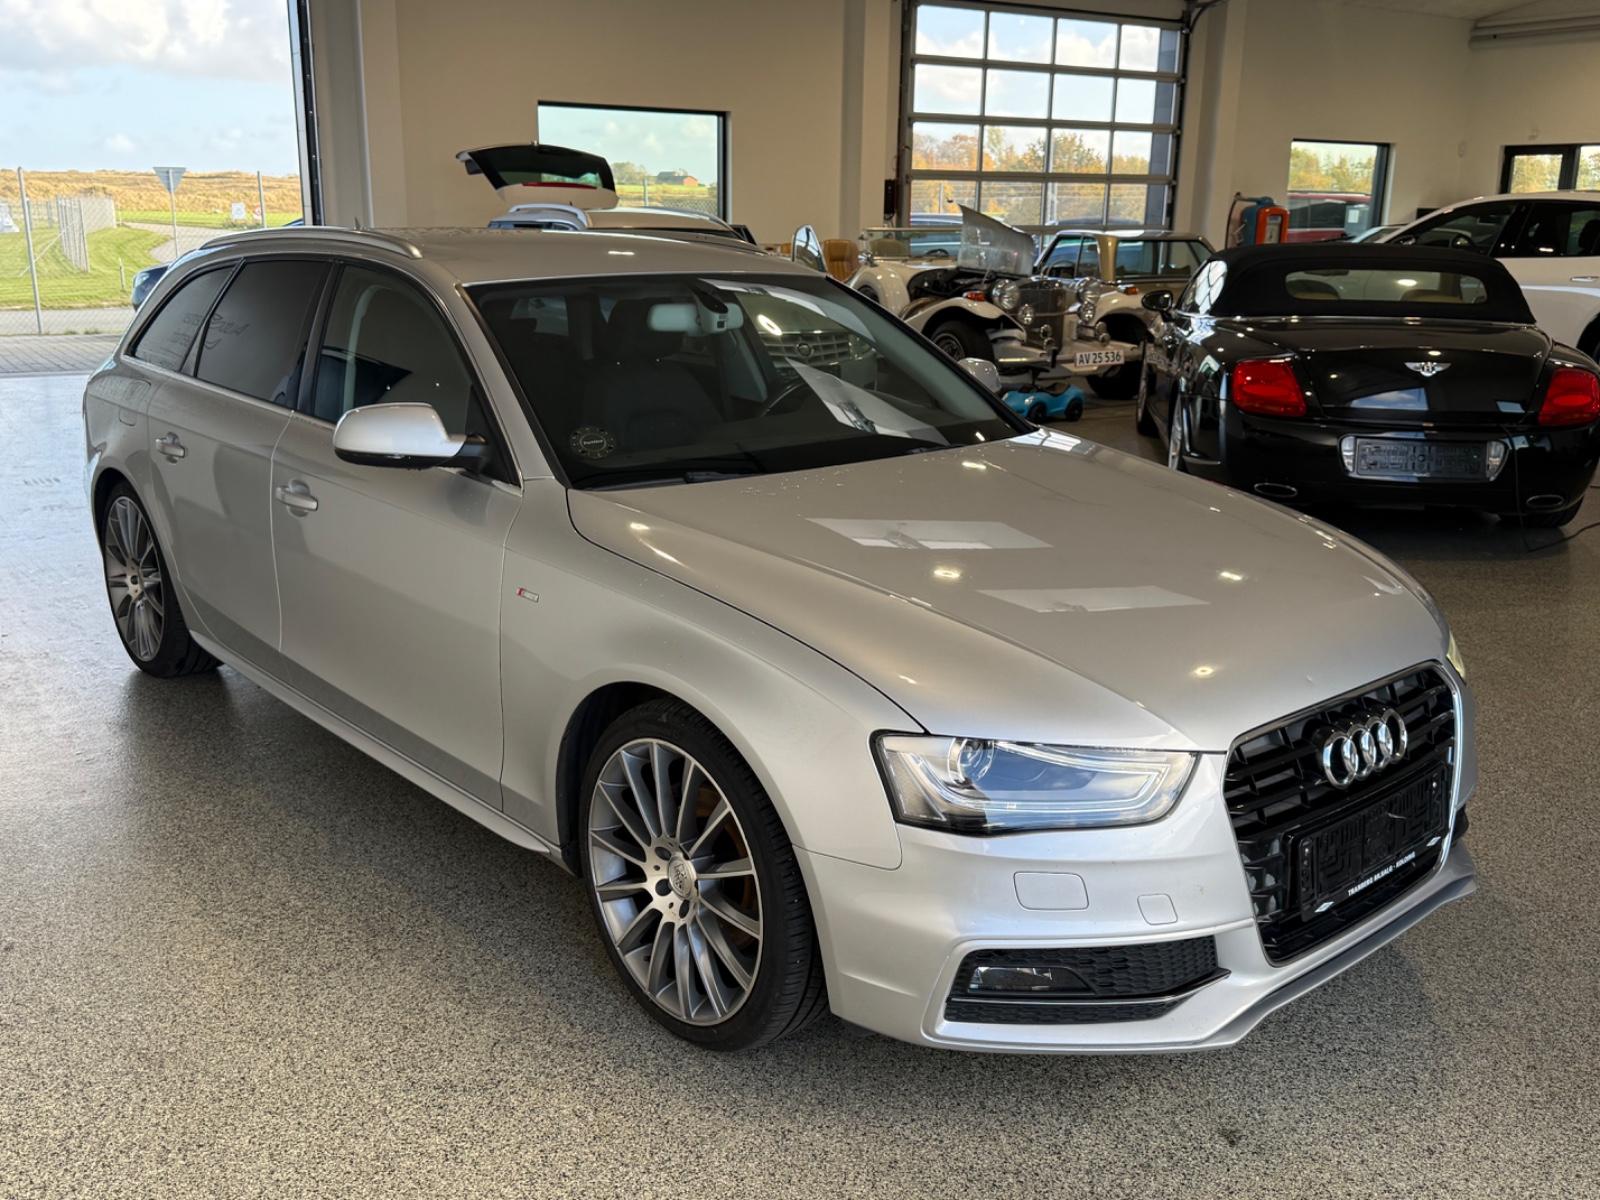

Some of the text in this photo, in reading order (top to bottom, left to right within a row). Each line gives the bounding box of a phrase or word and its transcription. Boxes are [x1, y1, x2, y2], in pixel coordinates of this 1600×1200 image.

[1079, 351, 1120, 364] AV 25 536
